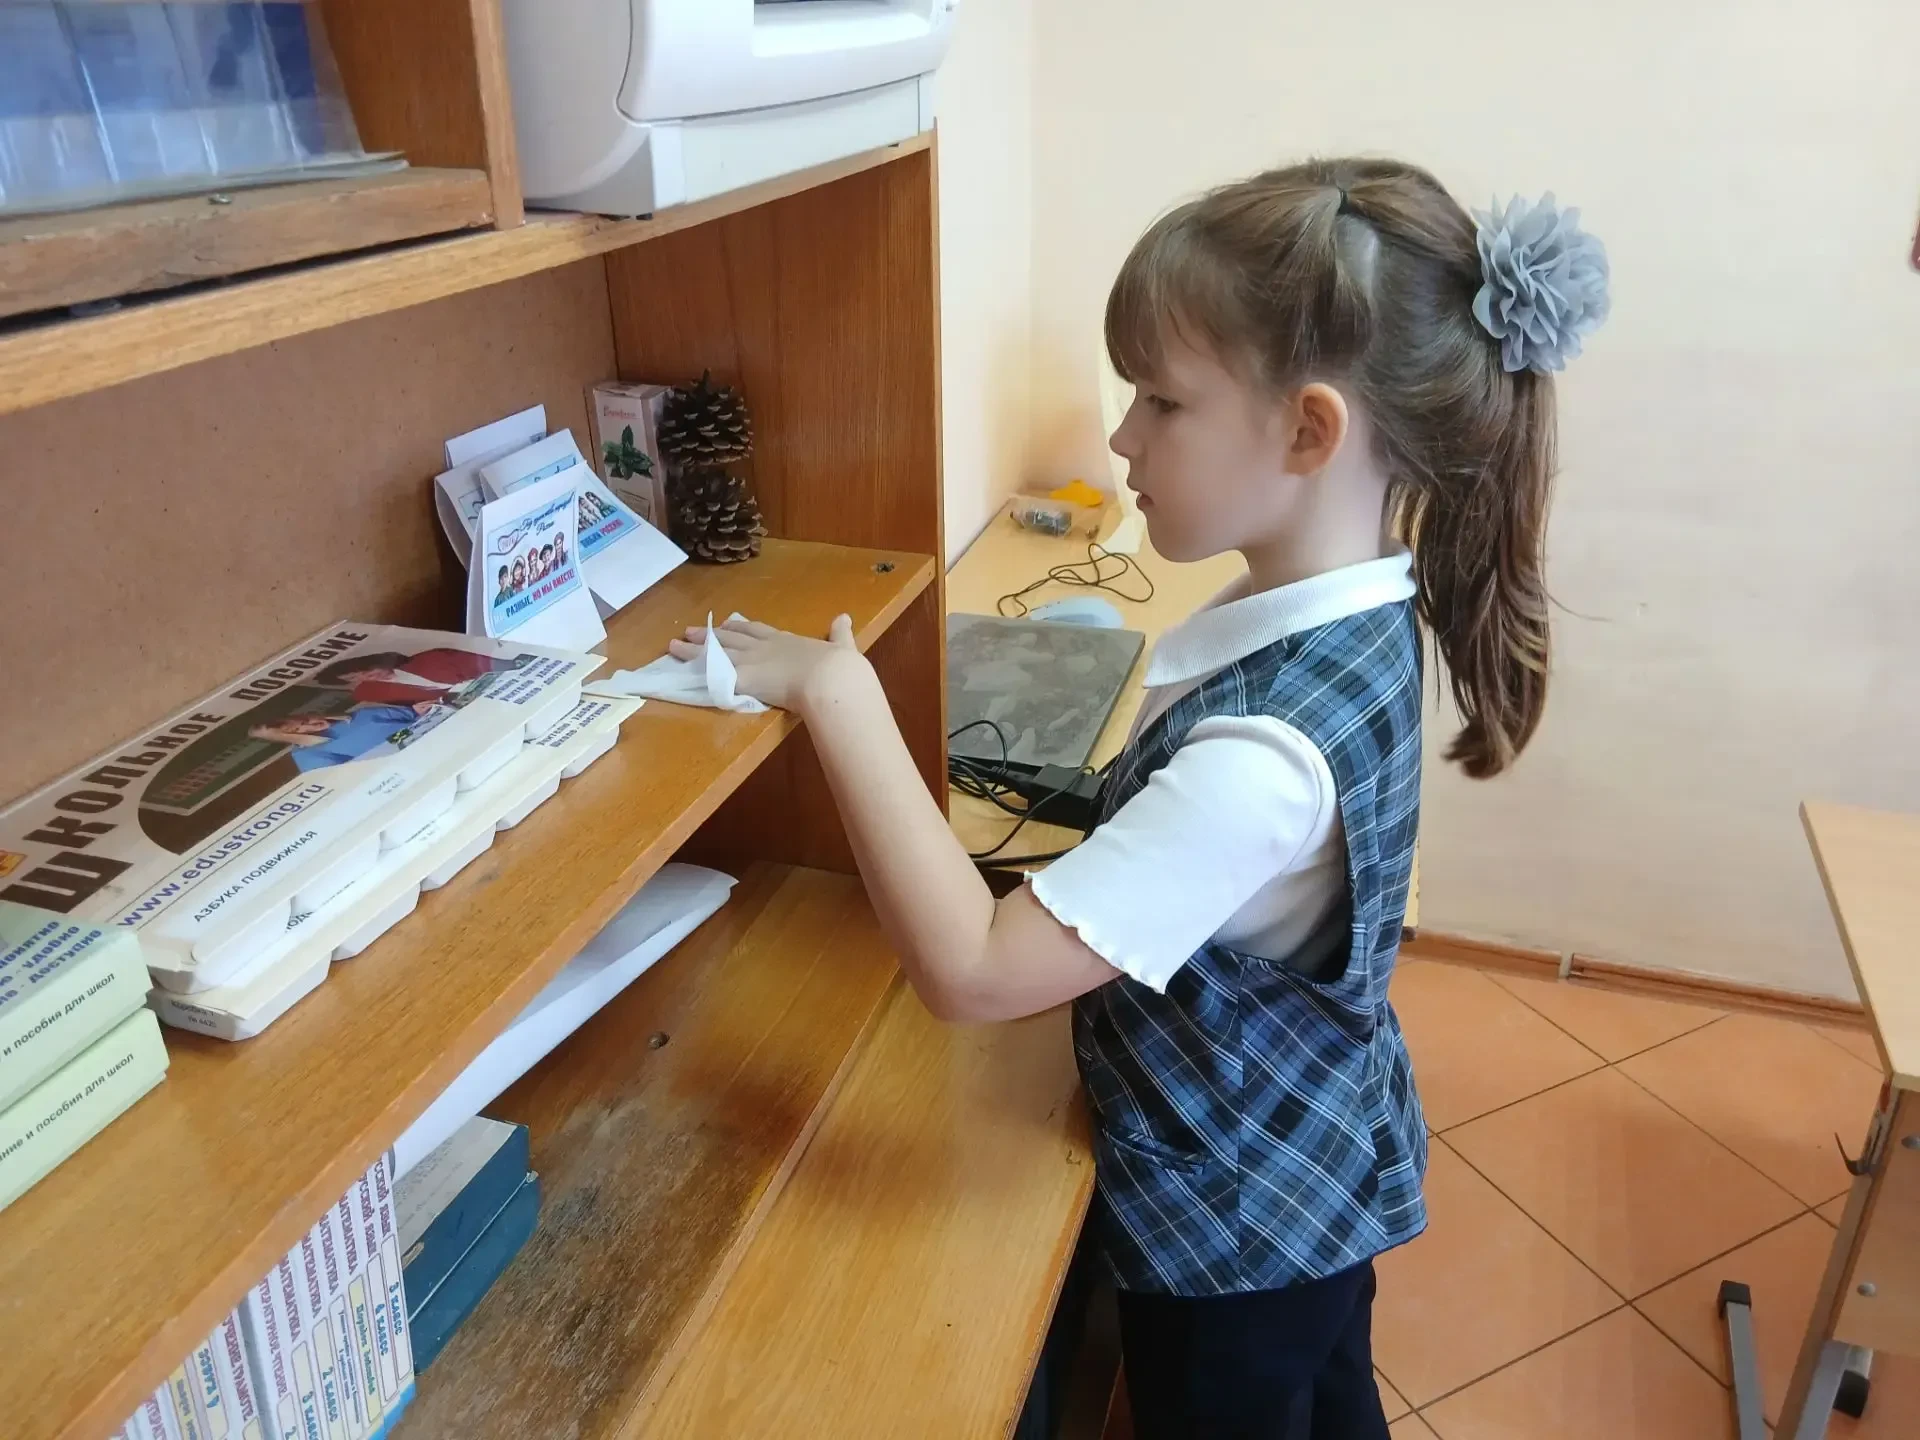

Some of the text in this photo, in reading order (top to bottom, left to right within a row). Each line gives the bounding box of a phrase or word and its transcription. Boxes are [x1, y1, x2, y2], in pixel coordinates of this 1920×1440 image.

[505, 594, 533, 618] РАЗНЫЕ,
[541, 582, 553, 597] МЫ
[0, 711, 226, 914] ШКОЛЬНОЕ
[229, 630, 369, 702] ПОСОБИЕ
[117, 784, 326, 928] www.edustrong.ru
[194, 884, 245, 923] АЗБУКА
[240, 830, 318, 885] ПОДВИЖНАЯ
[3, 972, 116, 1057] и пособия для школ
[25, 1130, 35, 1141] и
[36, 1092, 83, 1133] пособия
[84, 1075, 106, 1097] для
[106, 1052, 135, 1078] школ
[359, 1172, 375, 1223] УССКИЙ
[374, 1157, 389, 1203] ССКИЙ
[259, 1277, 281, 1355] ТЕРАТУРНОЕ
[389, 1281, 400, 1293] 3
